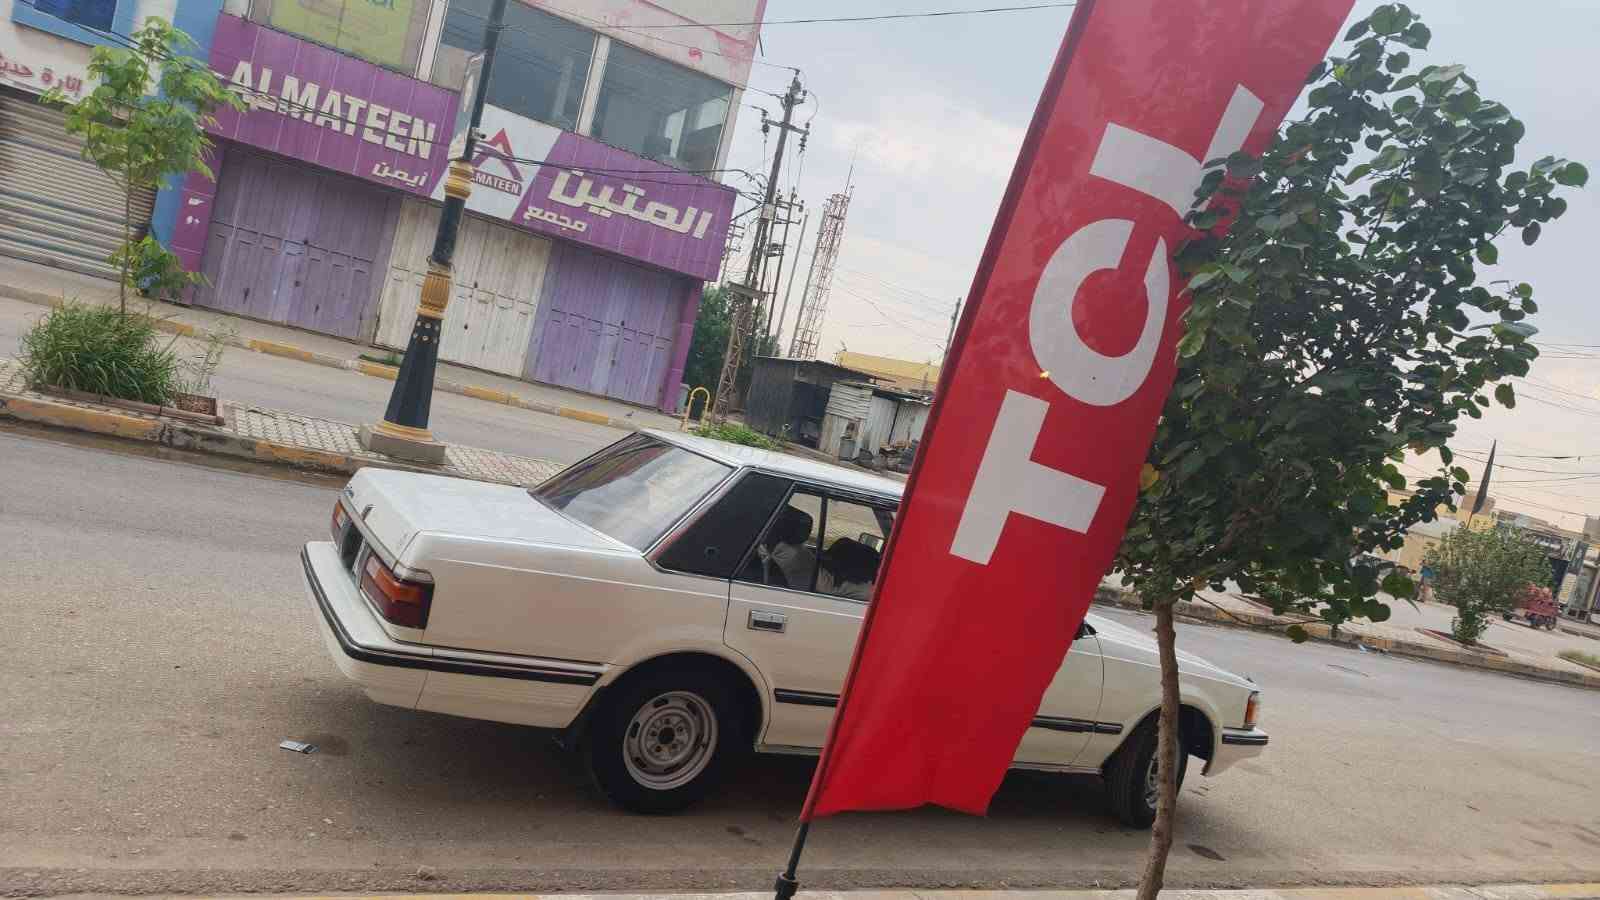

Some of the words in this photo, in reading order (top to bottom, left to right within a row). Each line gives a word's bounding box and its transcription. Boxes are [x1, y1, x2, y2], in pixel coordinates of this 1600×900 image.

[227, 60, 436, 160] ALMATEEN
[523, 205, 588, 232] مجمع
[549, 168, 713, 240] المتين
[949, 83, 1265, 565] TCL
